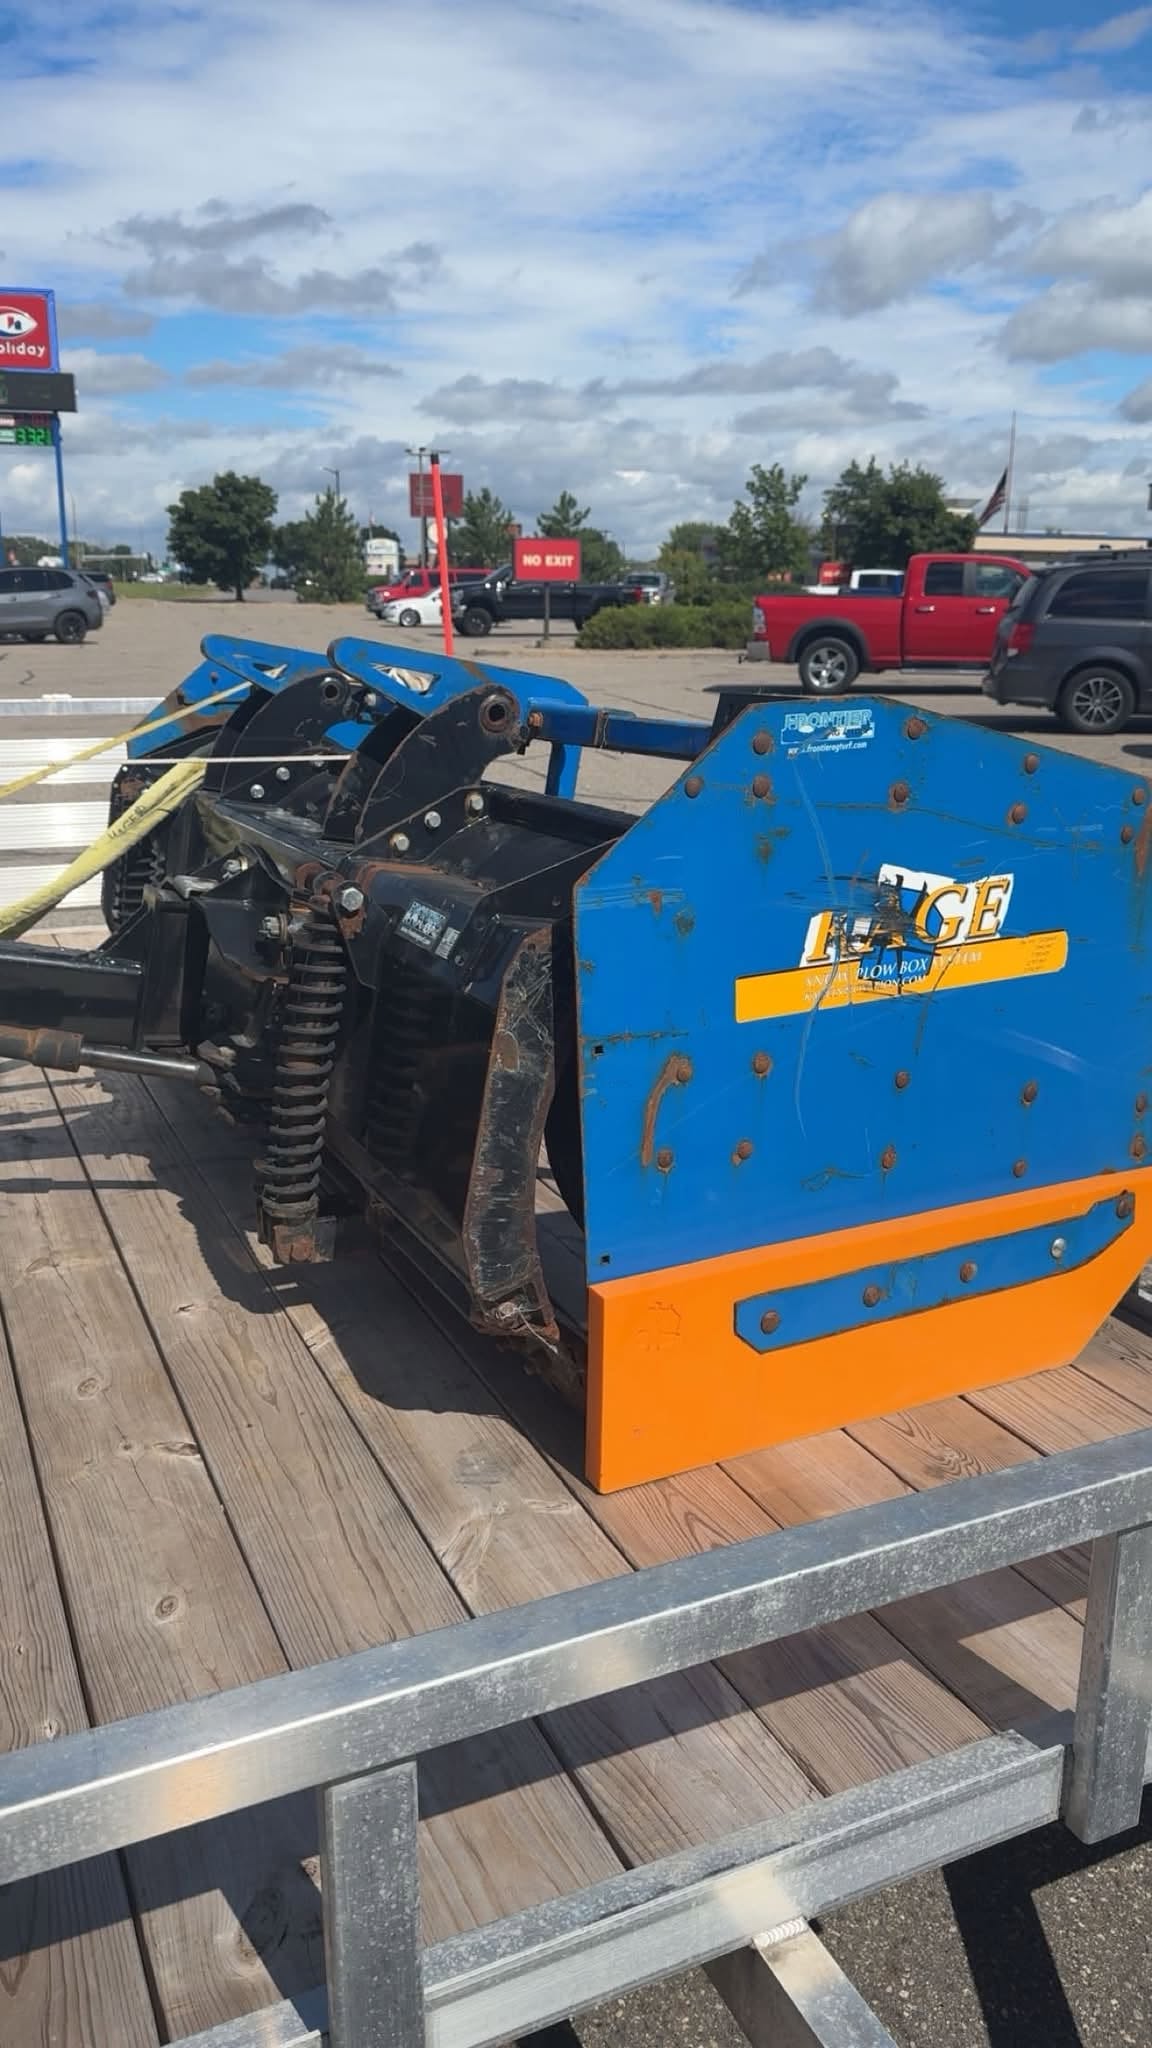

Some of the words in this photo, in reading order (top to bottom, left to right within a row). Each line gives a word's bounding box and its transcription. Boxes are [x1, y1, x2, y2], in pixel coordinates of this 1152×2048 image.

[0, 341, 46, 358] oliday
[523, 554, 542, 567] NO
[545, 554, 575, 568] EXIT
[784, 709, 873, 729] FRONTIER
[855, 961, 899, 980] PLOW
[899, 957, 929, 976] BOX
